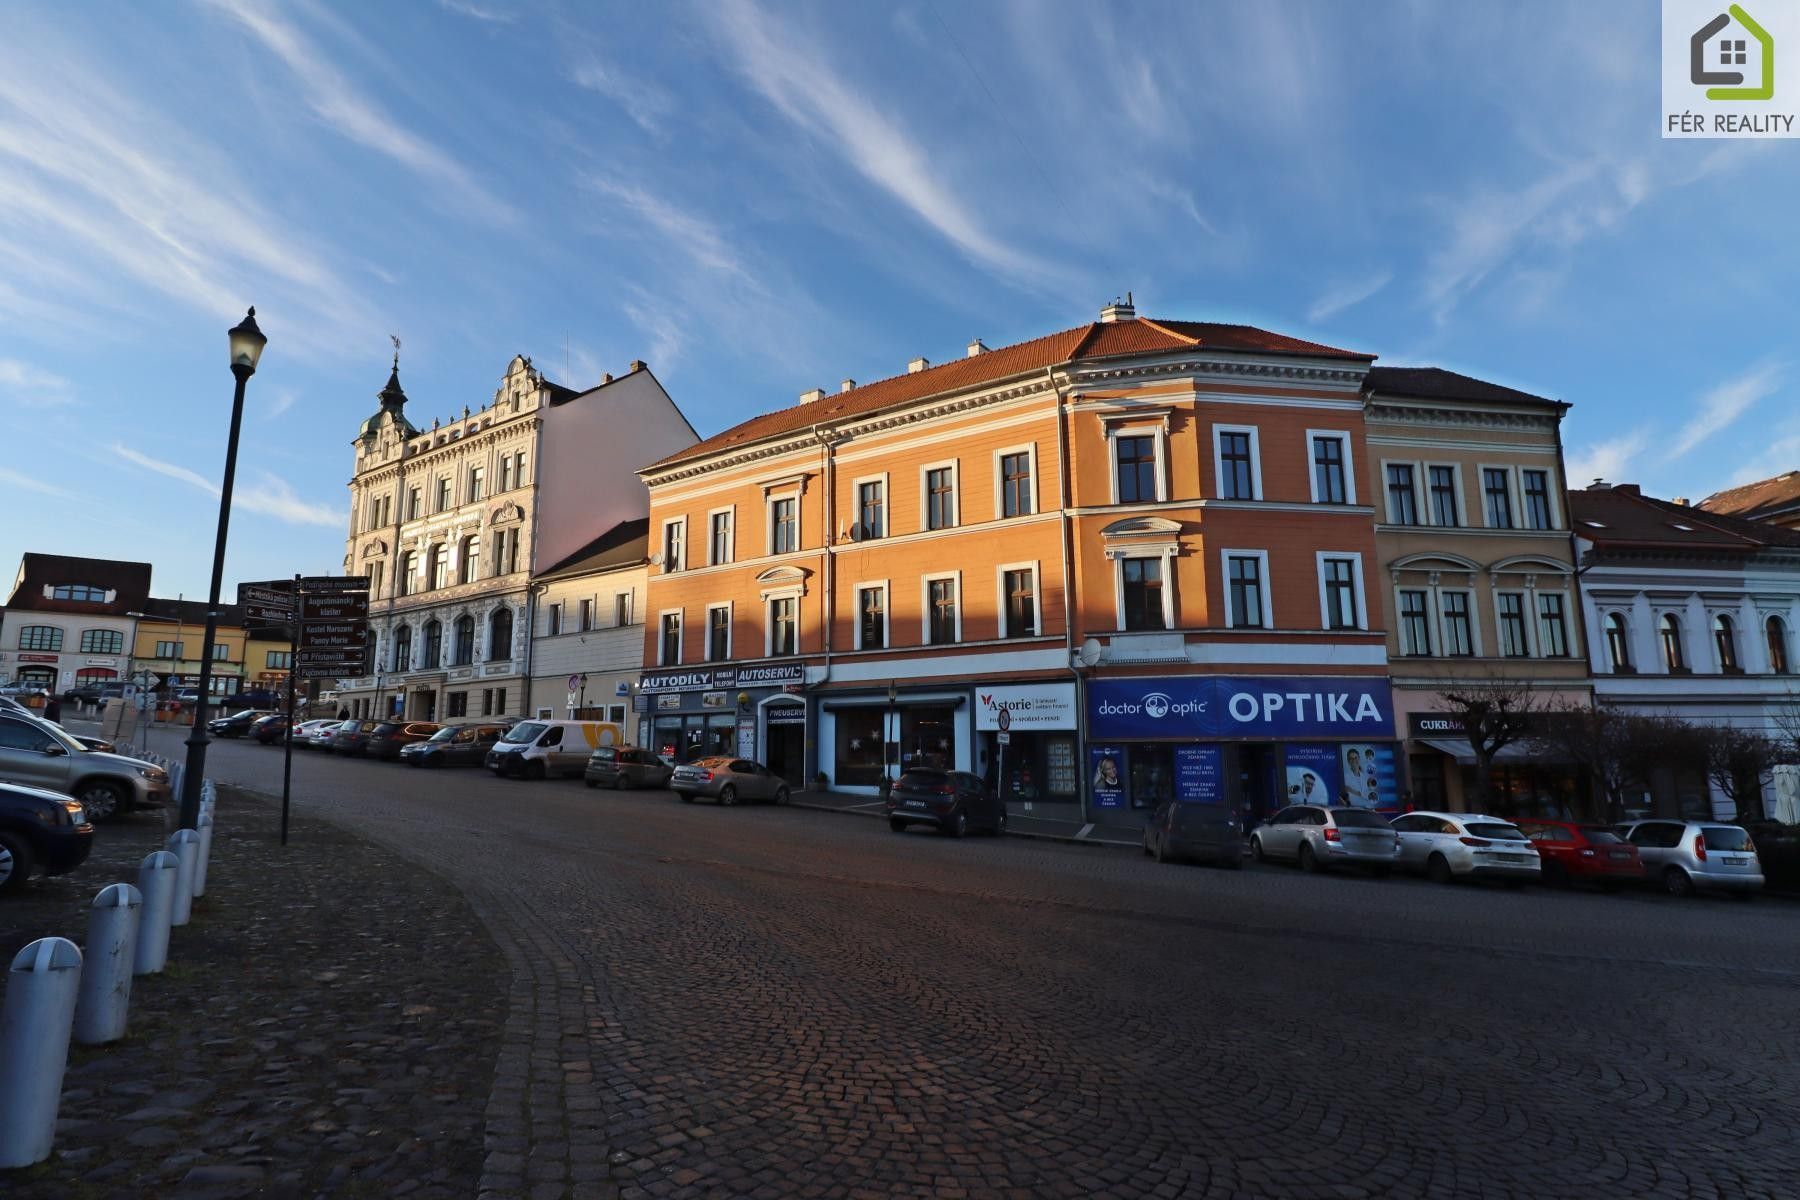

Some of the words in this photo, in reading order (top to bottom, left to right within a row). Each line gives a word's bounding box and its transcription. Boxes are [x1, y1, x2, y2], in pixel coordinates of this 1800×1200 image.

[641, 673, 710, 689] AUTODÍLY
[989, 698, 1032, 711] Astorie
[1098, 699, 1142, 714] doctor
[1171, 699, 1206, 717] optic
[1228, 692, 1383, 722] OPTIKA
[769, 708, 805, 718] PNEUSERVI
